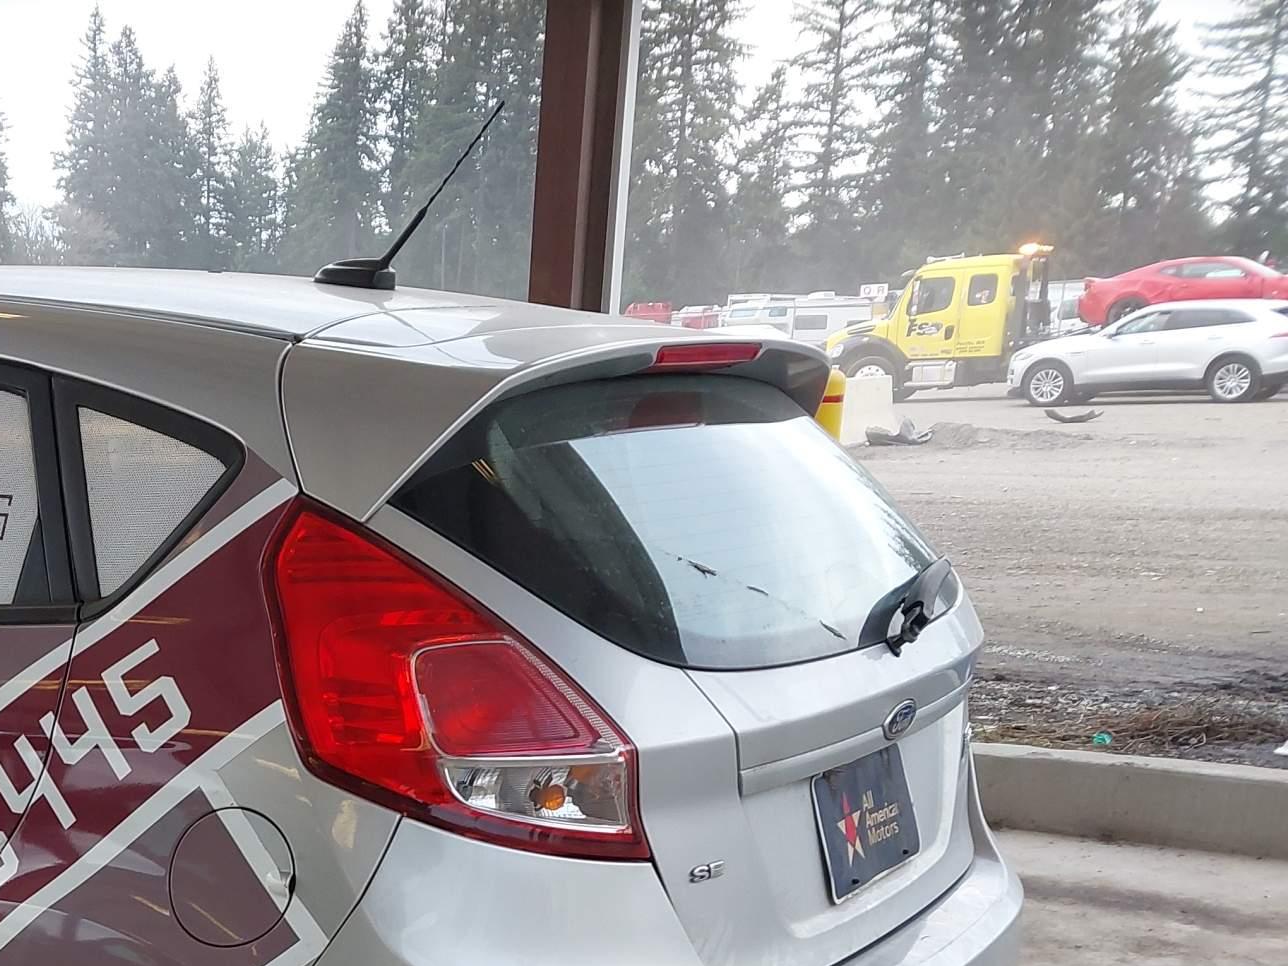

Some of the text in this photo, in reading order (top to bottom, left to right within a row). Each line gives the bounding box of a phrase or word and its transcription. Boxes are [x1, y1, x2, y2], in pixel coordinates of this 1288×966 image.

[863, 790, 874, 811] All
[865, 802, 901, 828] America
[868, 821, 900, 845] Motors
[689, 860, 725, 883] SE
